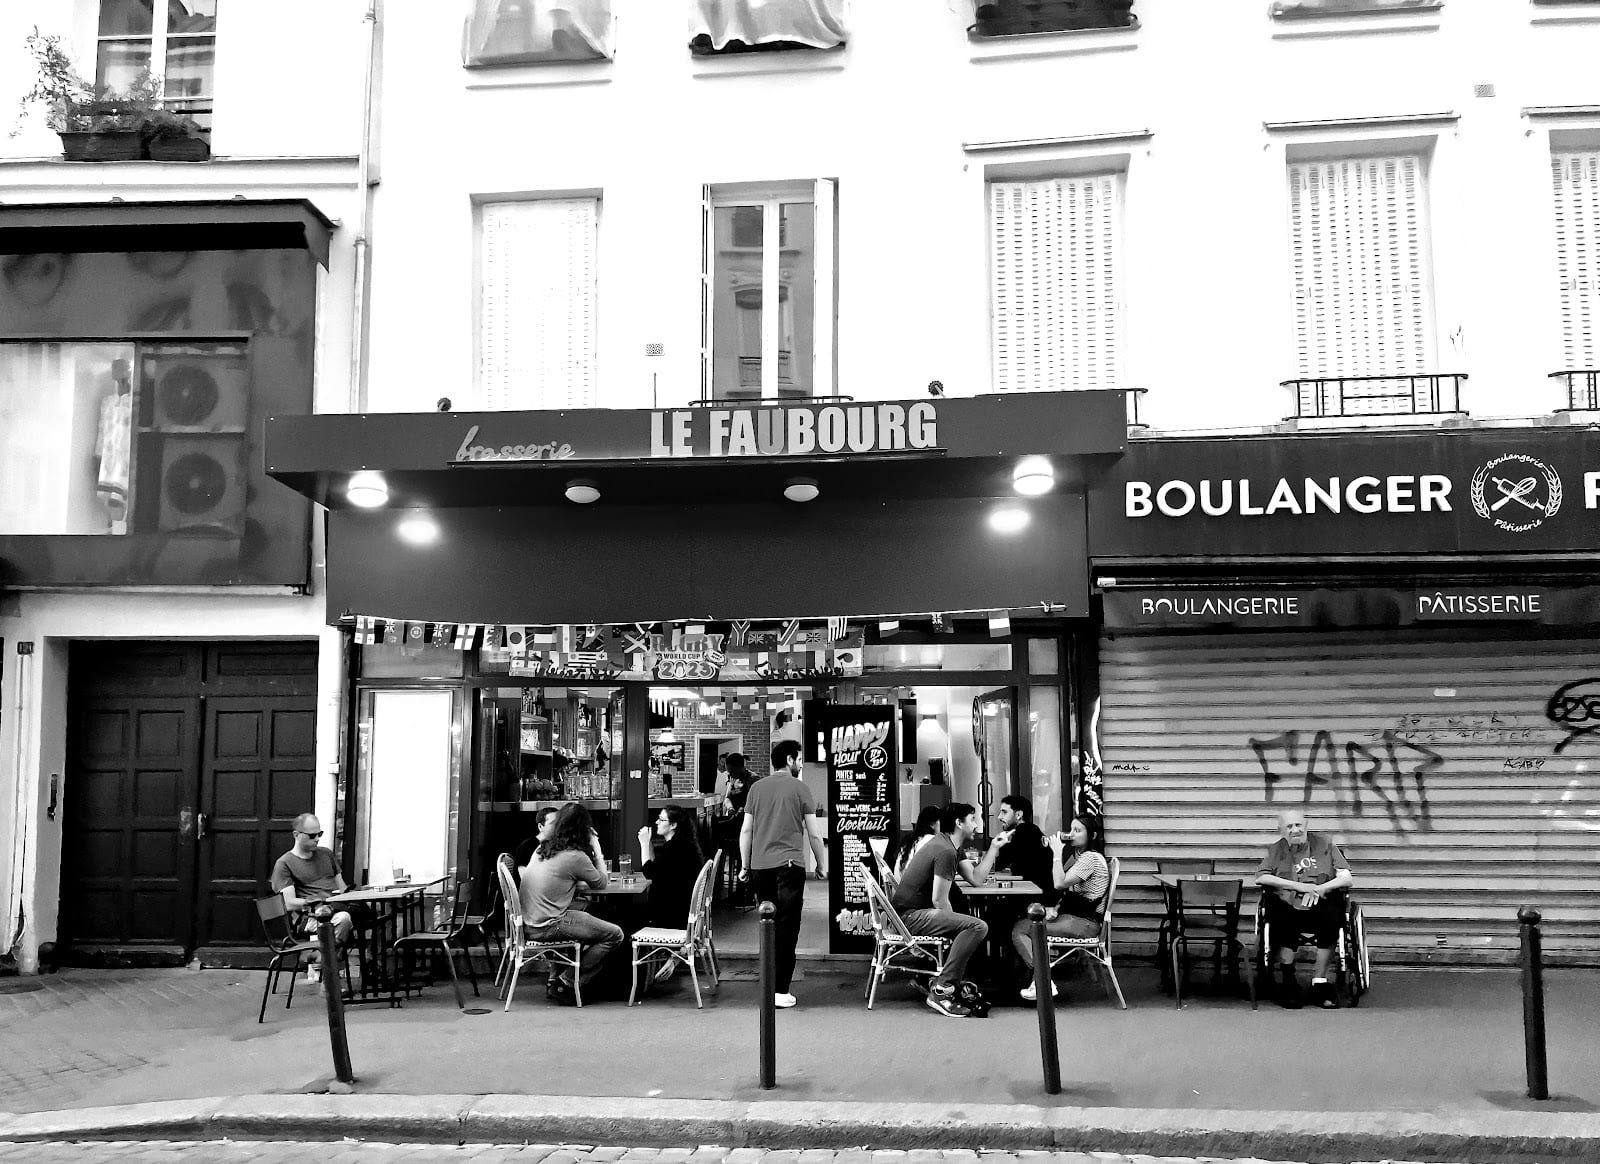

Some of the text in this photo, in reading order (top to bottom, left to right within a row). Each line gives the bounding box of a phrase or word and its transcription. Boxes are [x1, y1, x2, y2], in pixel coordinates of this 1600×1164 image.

[650, 402, 937, 457] LE FAUBOURG
[455, 425, 575, 461] brasserie
[1486, 453, 1544, 469] Boulangerie
[1125, 474, 1453, 517] BOULANGER
[1494, 518, 1543, 532] Pâtisserie
[1141, 597, 1299, 616] BOULANGERIE
[1418, 592, 1541, 614] PÂTISSERIE
[659, 660, 716, 680] 2023
[831, 721, 890, 753] HAPPY
[836, 815, 890, 832] Cocktails
